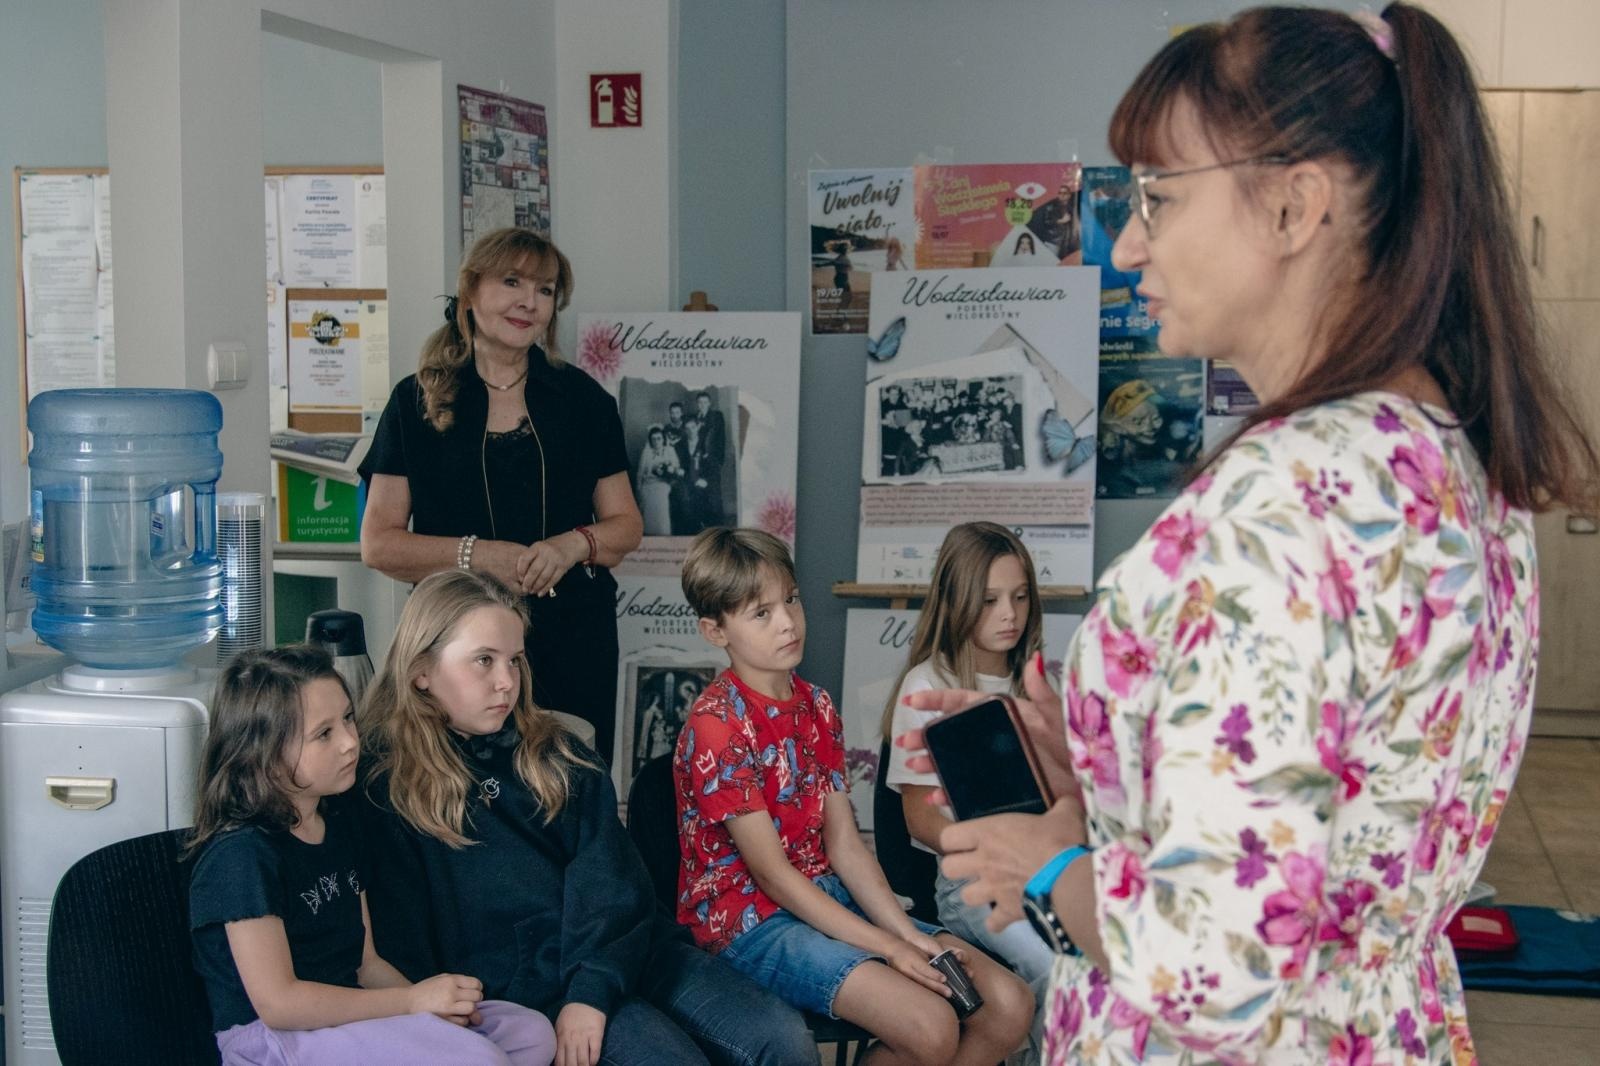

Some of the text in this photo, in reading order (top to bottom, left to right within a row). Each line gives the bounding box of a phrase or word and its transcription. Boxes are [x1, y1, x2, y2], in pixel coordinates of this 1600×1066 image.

[823, 178, 903, 215] Uwolnij
[902, 275, 1067, 308] Wodzisławian
[957, 304, 1004, 313] PORTRET
[945, 311, 1022, 320] WIELOKROTNY
[608, 321, 768, 353] Wodzisławian
[661, 352, 708, 360] PORTRET
[297, 516, 349, 525] informacja
[297, 527, 349, 537] turystyczna
[655, 619, 694, 627] PORTRE
[643, 627, 698, 635] WIELOKRO
